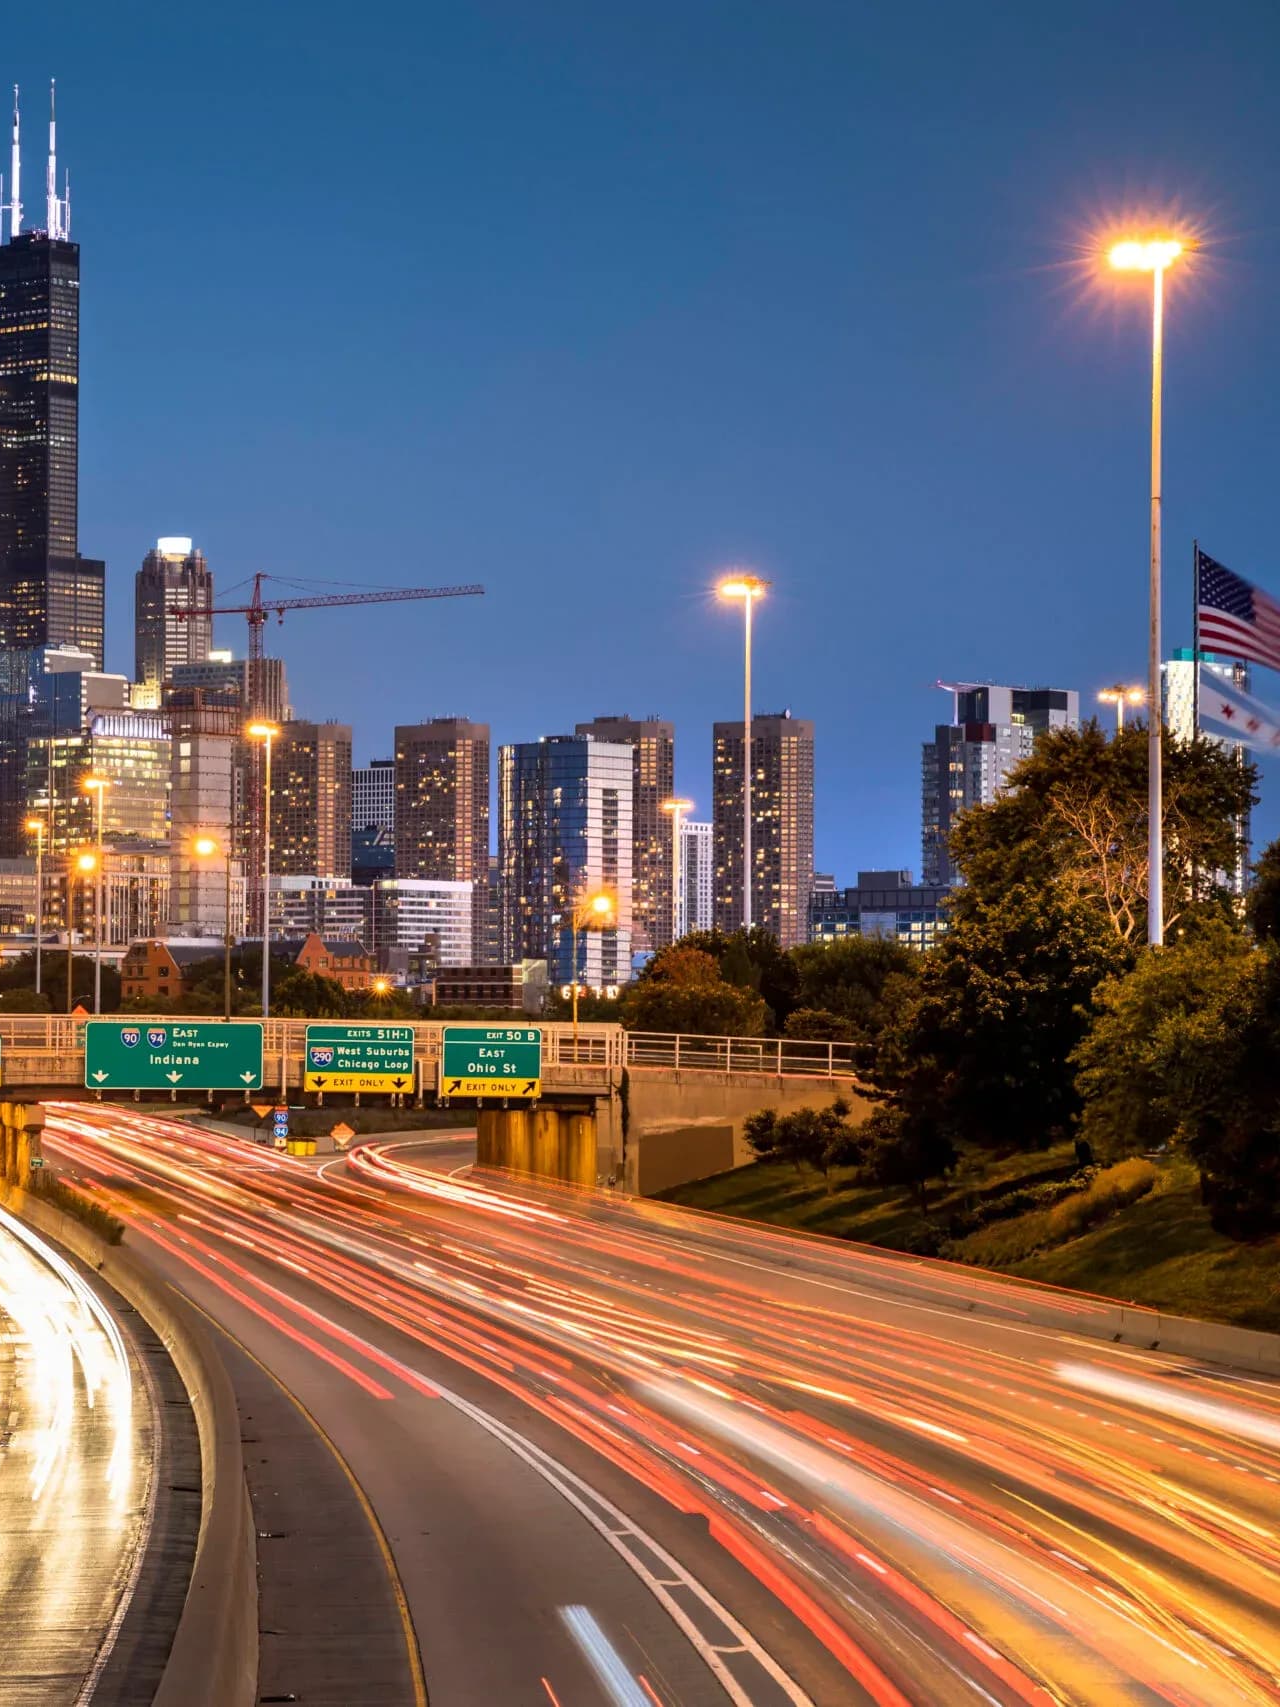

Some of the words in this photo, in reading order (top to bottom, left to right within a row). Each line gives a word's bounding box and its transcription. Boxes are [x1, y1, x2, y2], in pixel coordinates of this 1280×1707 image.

[124, 1033, 137, 1043] 90
[150, 1033, 163, 1043] 94
[172, 1028, 199, 1038] EAST
[347, 1030, 371, 1038] EXITS
[506, 1031, 522, 1041] 50
[527, 1031, 535, 1041] B
[336, 1047, 361, 1055] West
[366, 1047, 410, 1056] Suburbs
[479, 1048, 505, 1058] EAST
[149, 1054, 200, 1065] Indiana
[313, 1052, 332, 1062] 290
[337, 1059, 380, 1070] Chicago
[384, 1060, 409, 1070] Loop
[467, 1063, 497, 1073] Ohio
[503, 1063, 517, 1073] St
[359, 1079, 385, 1087] ONLY
[466, 1083, 487, 1091] EXIT
[491, 1084, 517, 1092] ONLY
